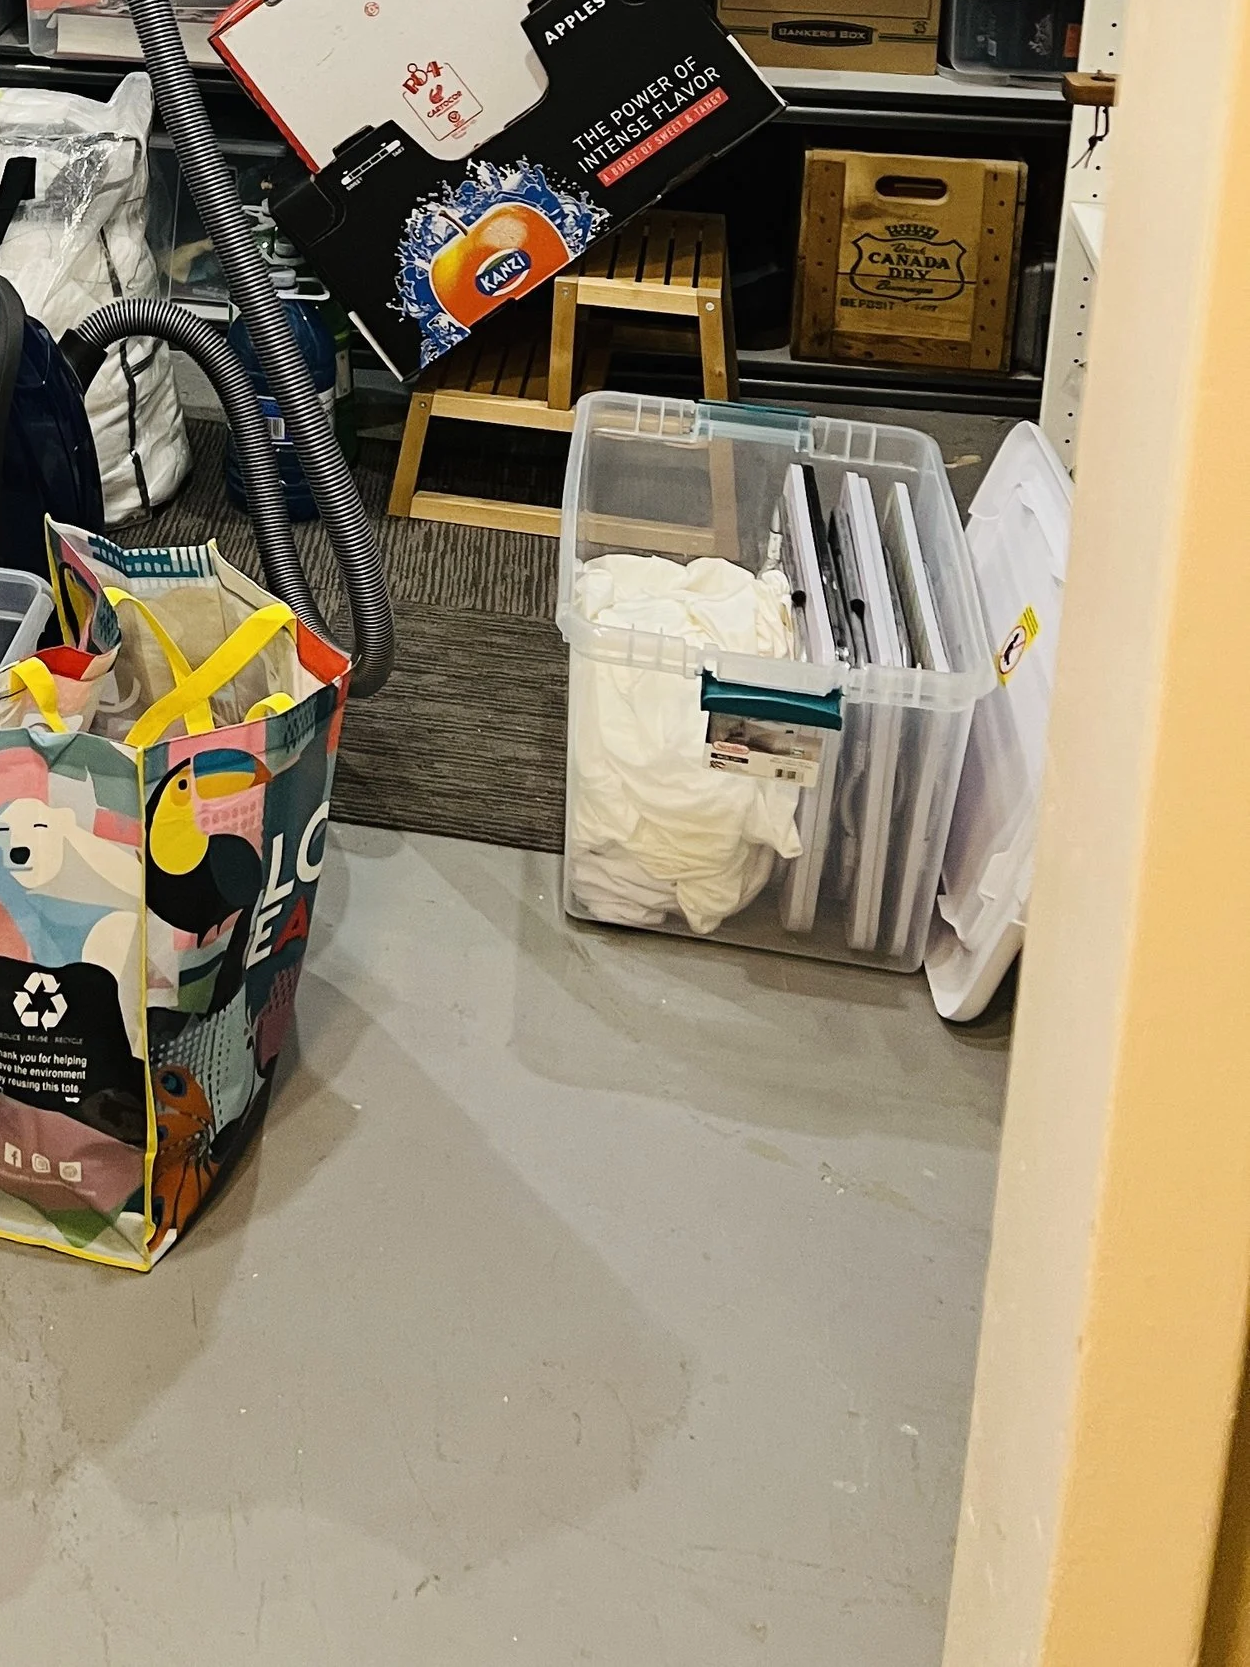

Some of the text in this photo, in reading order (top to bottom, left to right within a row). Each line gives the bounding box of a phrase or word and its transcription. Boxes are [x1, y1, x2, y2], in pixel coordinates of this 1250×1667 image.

[778, 27, 867, 40] BANKERS BOX
[572, 55, 697, 151] THE POWER OF
[577, 66, 721, 173] INTENSE FLAVOR
[602, 92, 723, 183] A BURST OF SWEET & TANGY
[868, 251, 951, 270] CANADA
[888, 267, 931, 280] DRY
[20, 1054, 37, 1064] you
[38, 1052, 52, 1064] for
[53, 1054, 88, 1069] helping
[13, 1064, 28, 1076] the
[29, 1067, 86, 1080] environment
[8, 1077, 41, 1093] reusing
[42, 1081, 59, 1092] this
[61, 1082, 82, 1094] tote.
